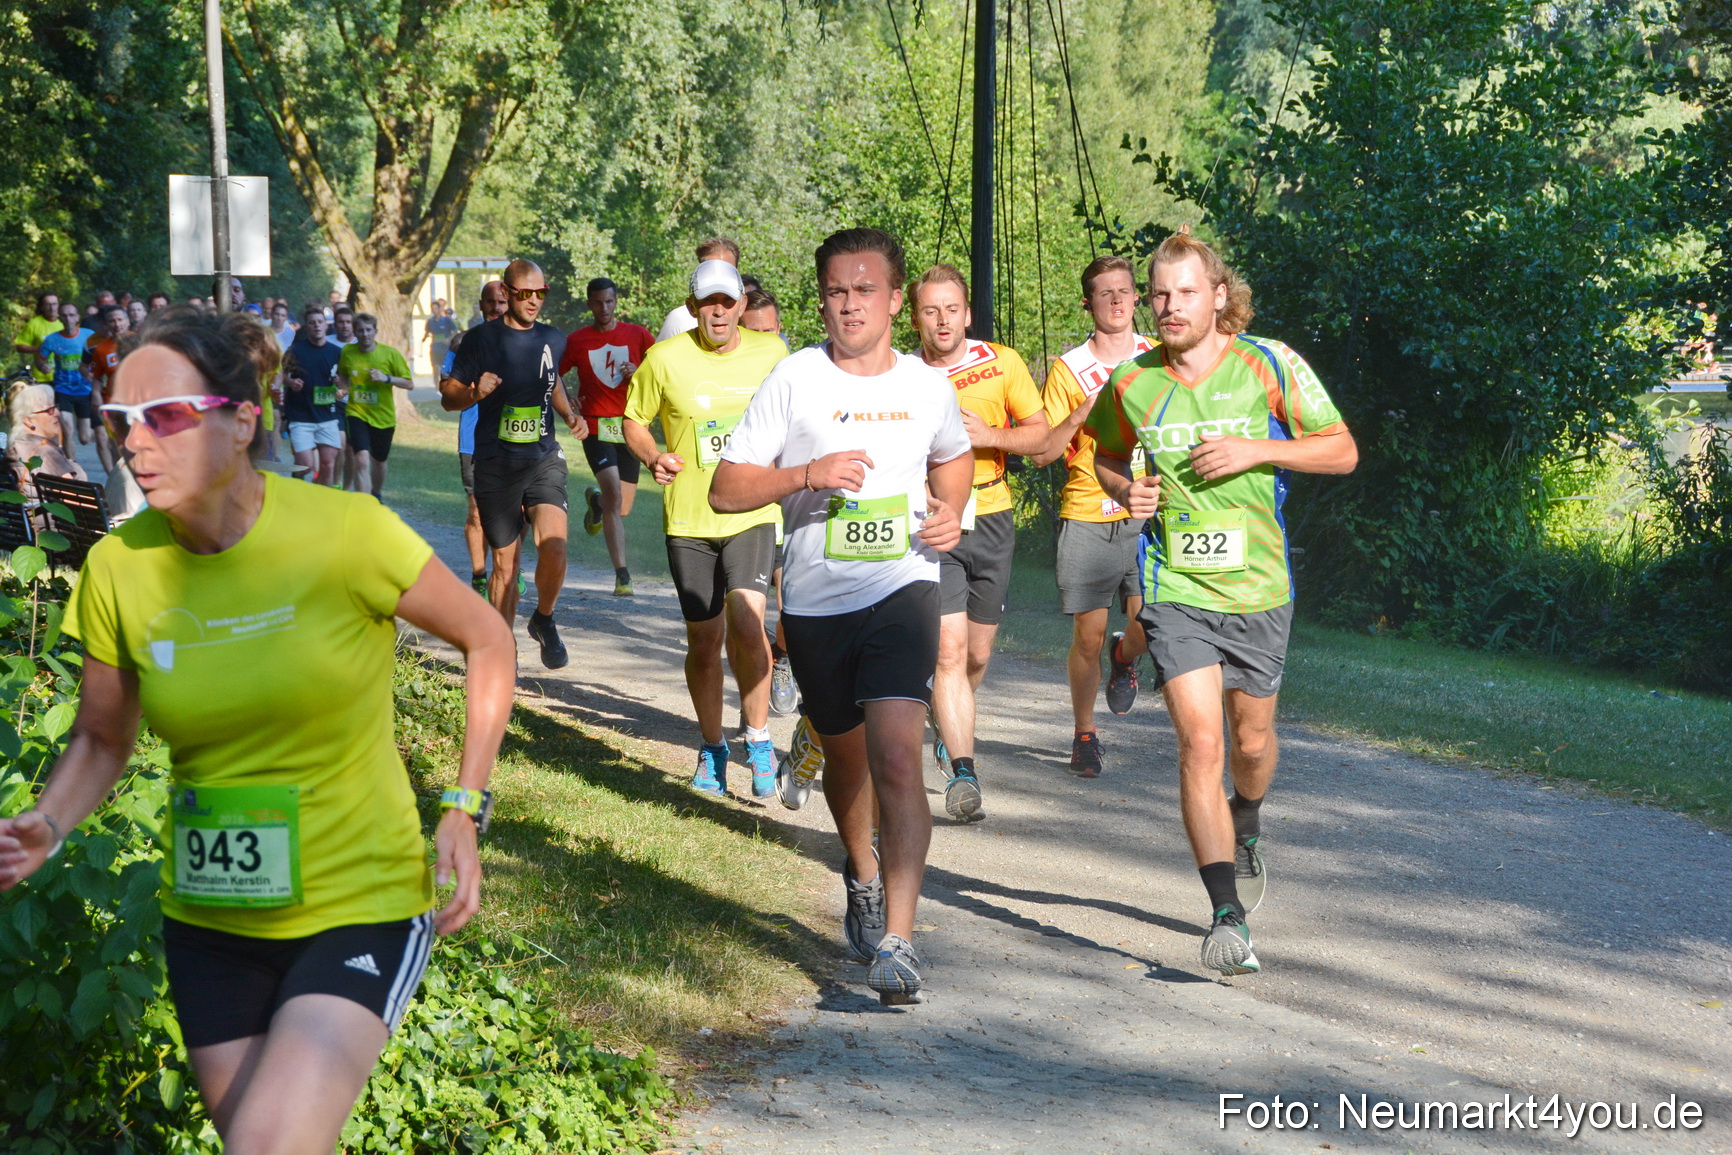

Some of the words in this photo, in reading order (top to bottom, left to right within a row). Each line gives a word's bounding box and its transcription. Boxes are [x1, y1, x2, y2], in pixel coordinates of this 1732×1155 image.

[954, 366, 1004, 390] BÖGL
[357, 391, 372, 400] 921
[504, 418, 536, 432] 1603
[853, 411, 915, 421] KLEBL
[1135, 416, 1252, 455] BOCK
[845, 520, 894, 543] 885
[844, 543, 862, 551] Lang
[1181, 532, 1228, 555] 232
[187, 829, 262, 872] 943
[230, 874, 271, 885] Kerstin
